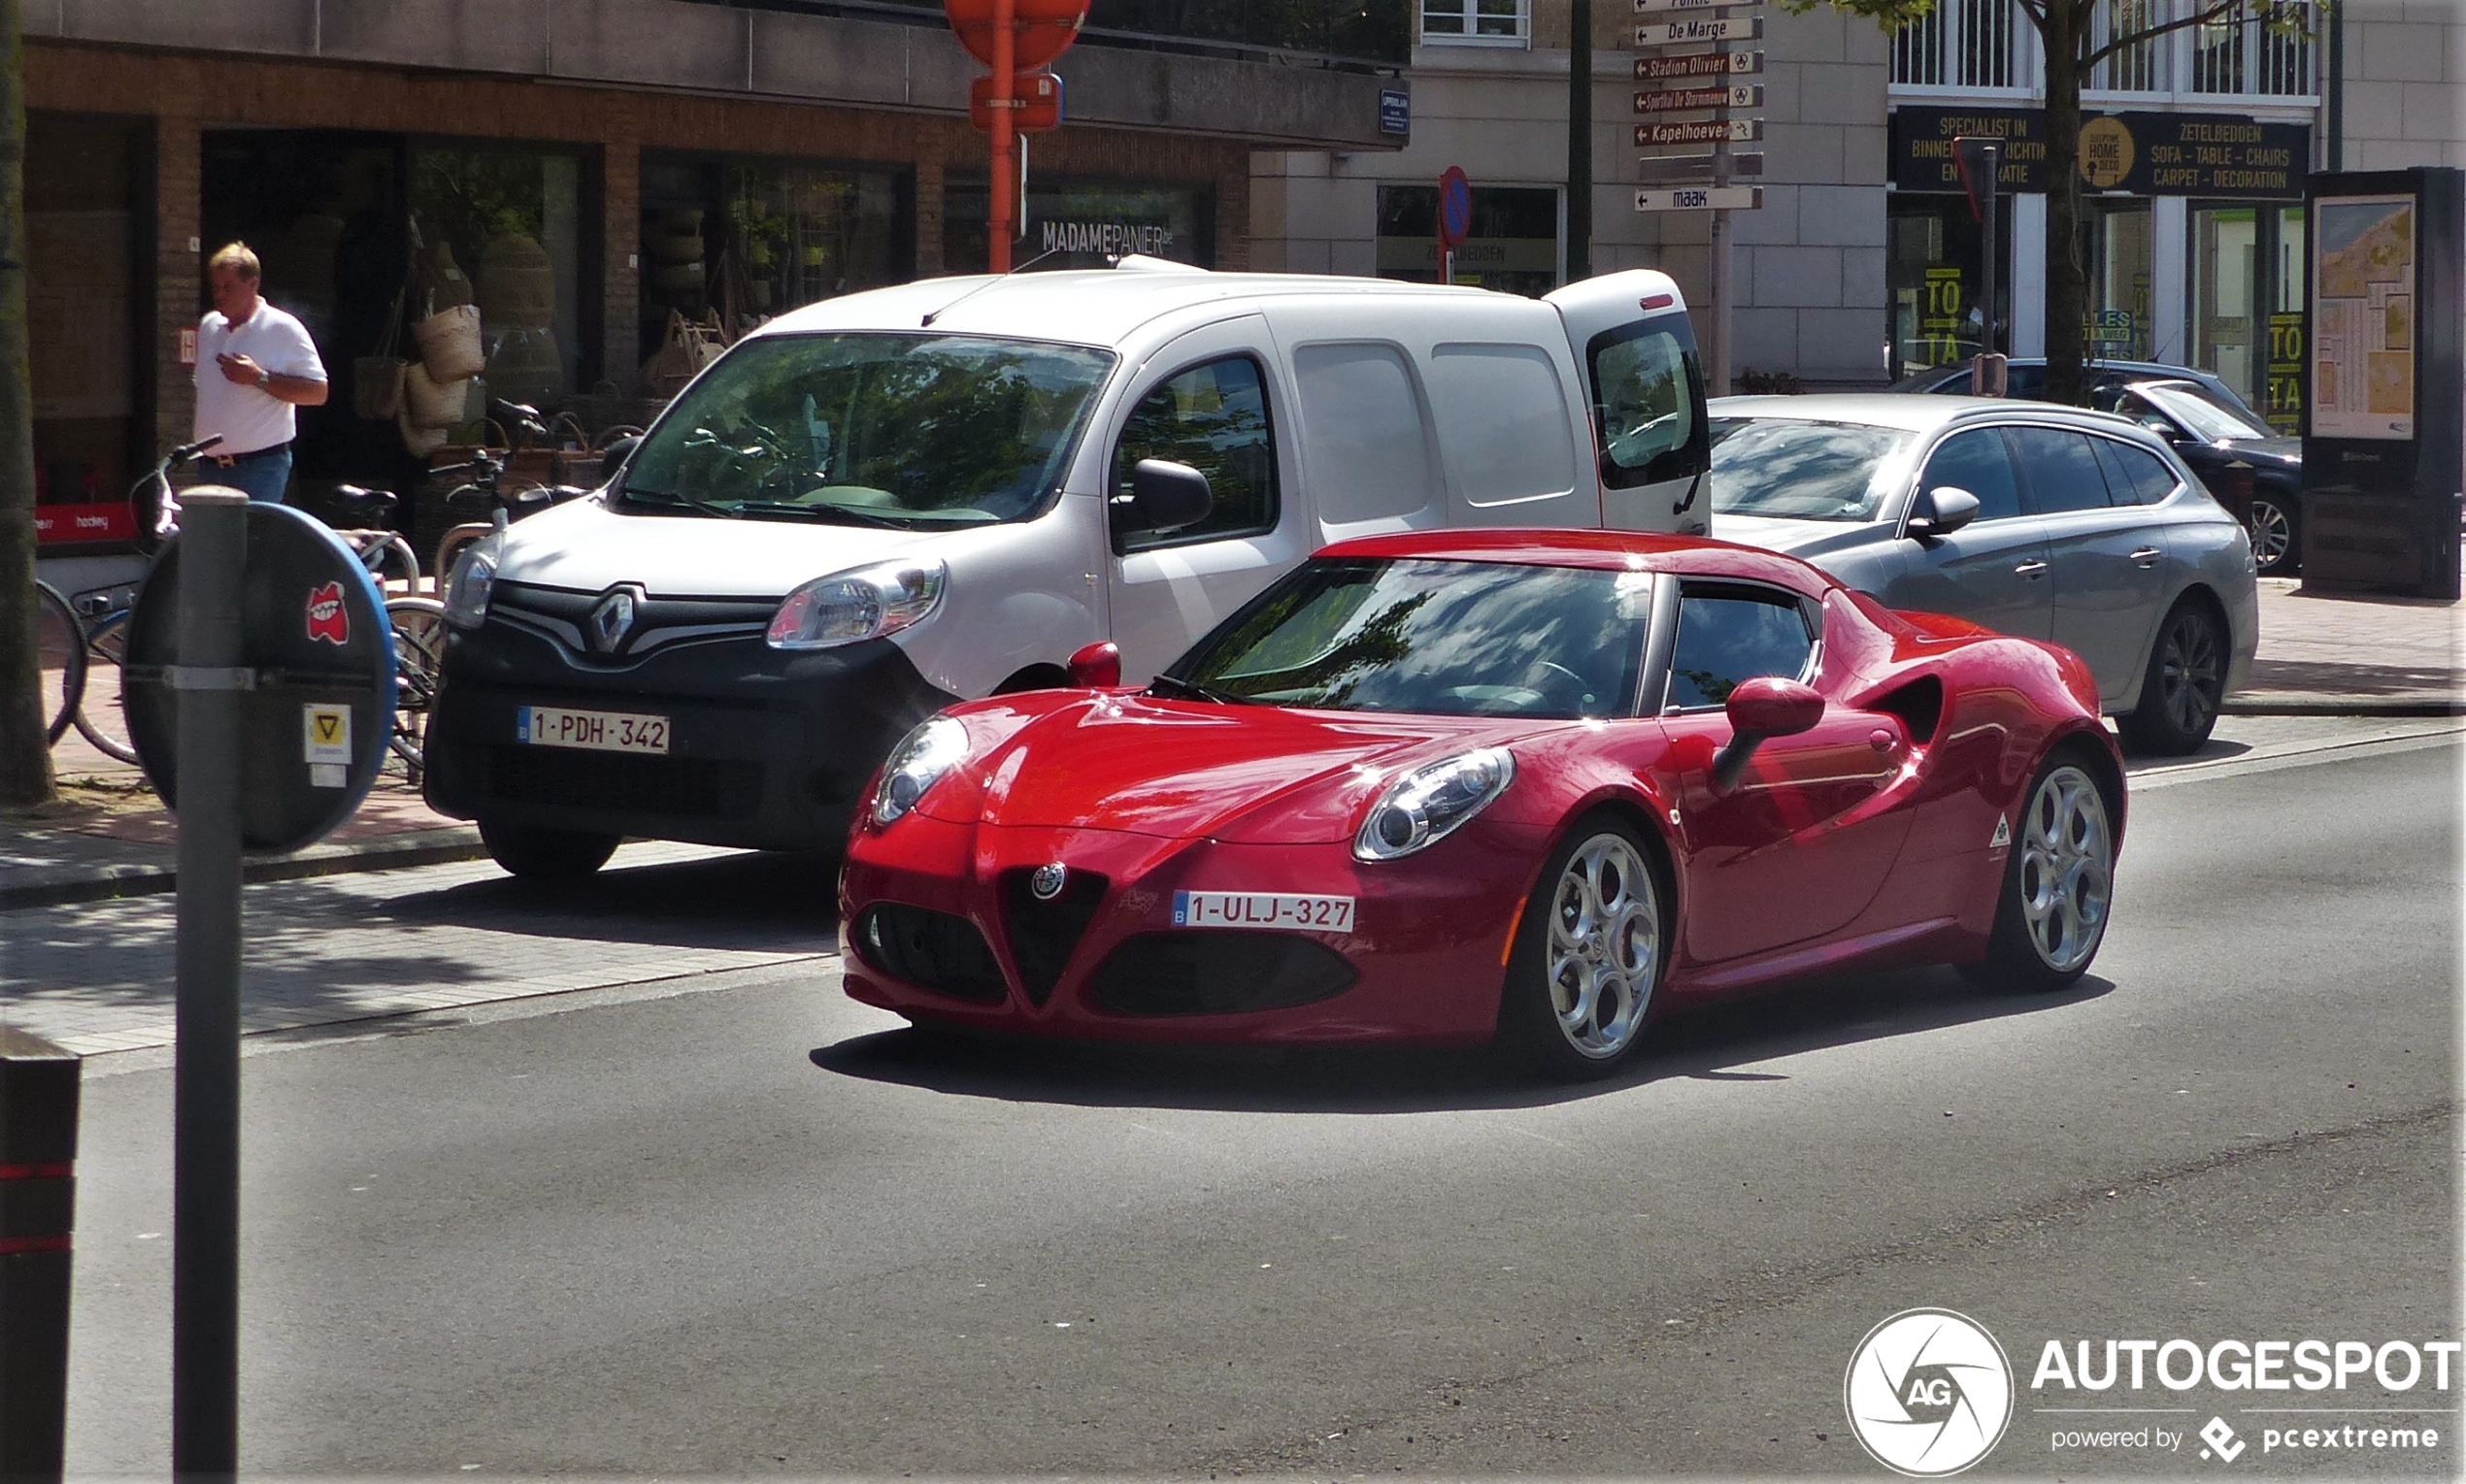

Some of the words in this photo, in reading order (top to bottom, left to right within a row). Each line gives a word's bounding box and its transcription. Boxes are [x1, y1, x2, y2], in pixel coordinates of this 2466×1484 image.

[1668, 23, 1684, 39] De
[1686, 20, 1727, 40] Marge
[1650, 61, 1686, 78] Stadion
[1689, 57, 1726, 74] Olivier
[1651, 124, 1723, 144] Kapelhoeve
[1940, 117, 2012, 136] SPECIALIST
[2014, 119, 2028, 137] IN
[2180, 123, 2262, 143] ZETELBEDDEN
[2089, 143, 2119, 159] HOME
[2150, 145, 2183, 163] SOFA
[2195, 147, 2232, 165] TABLE
[2246, 148, 2290, 167] CHAIRS
[1942, 163, 1958, 181] EN
[2098, 159, 2120, 172] DECO
[2152, 168, 2200, 186] CARPET
[2214, 170, 2287, 189] DECORATION
[1672, 191, 1708, 208] maak
[1925, 280, 1960, 315] TO
[1924, 333, 1959, 366] TA
[2269, 326, 2302, 360] TO
[2268, 378, 2301, 411] TA
[535, 712, 665, 748] 1-PDH-342
[1175, 910, 1184, 923] B
[1192, 896, 1350, 927] 1-ULJ-327
